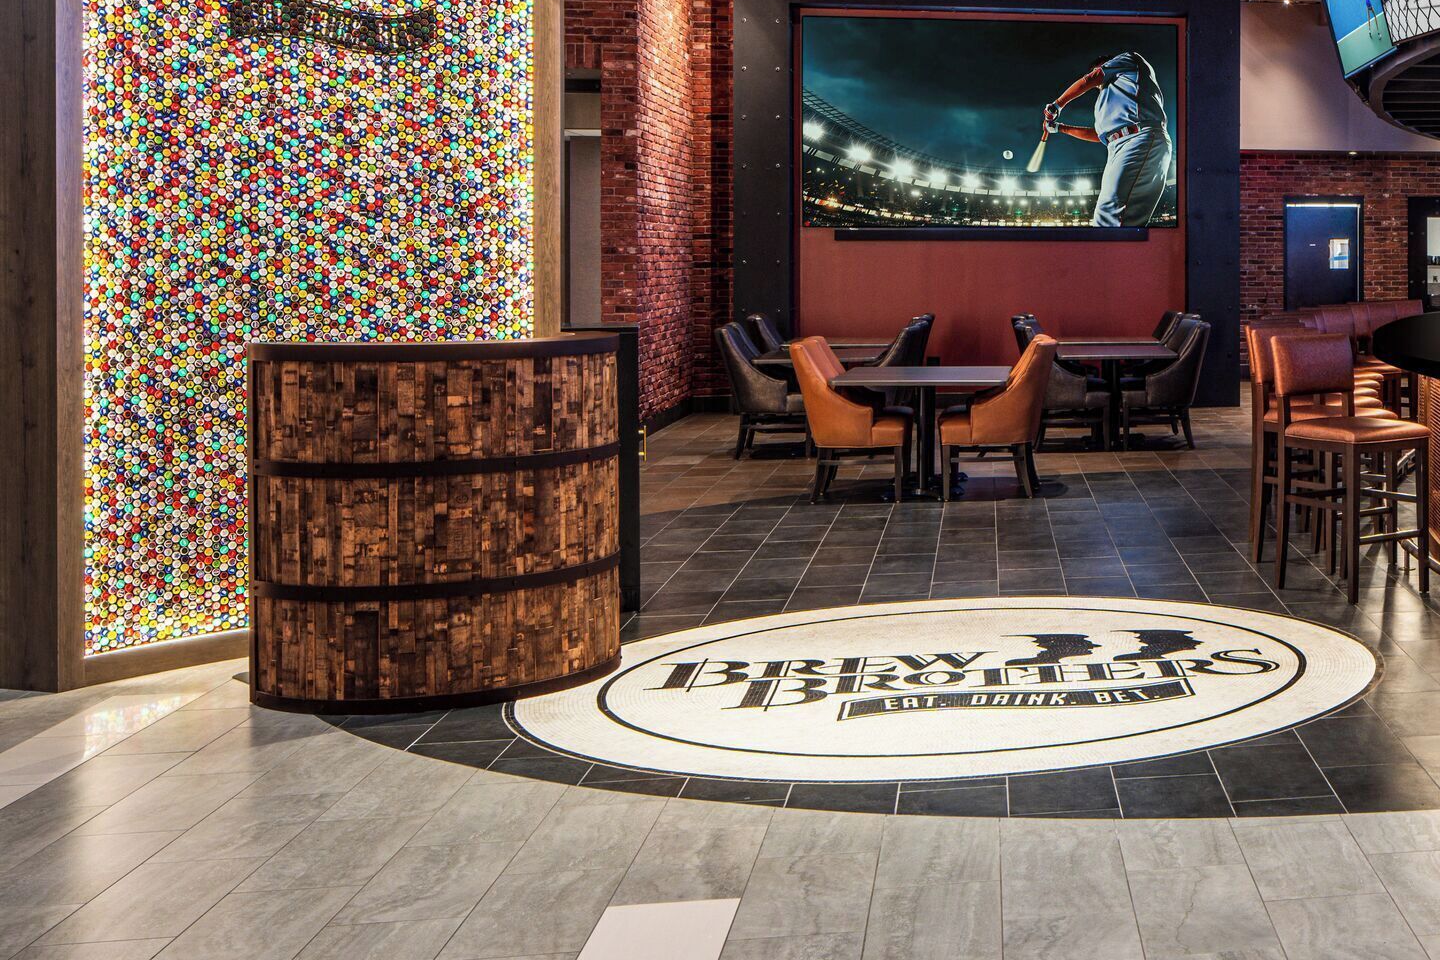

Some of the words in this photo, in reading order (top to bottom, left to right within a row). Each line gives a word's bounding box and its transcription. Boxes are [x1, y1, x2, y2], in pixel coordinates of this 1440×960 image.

[643, 651, 999, 692] BREW
[721, 647, 1281, 711] BROTHERS
[884, 694, 947, 711] EAT.
[970, 692, 1077, 707] DRINK.
[1096, 689, 1160, 705] BET.
